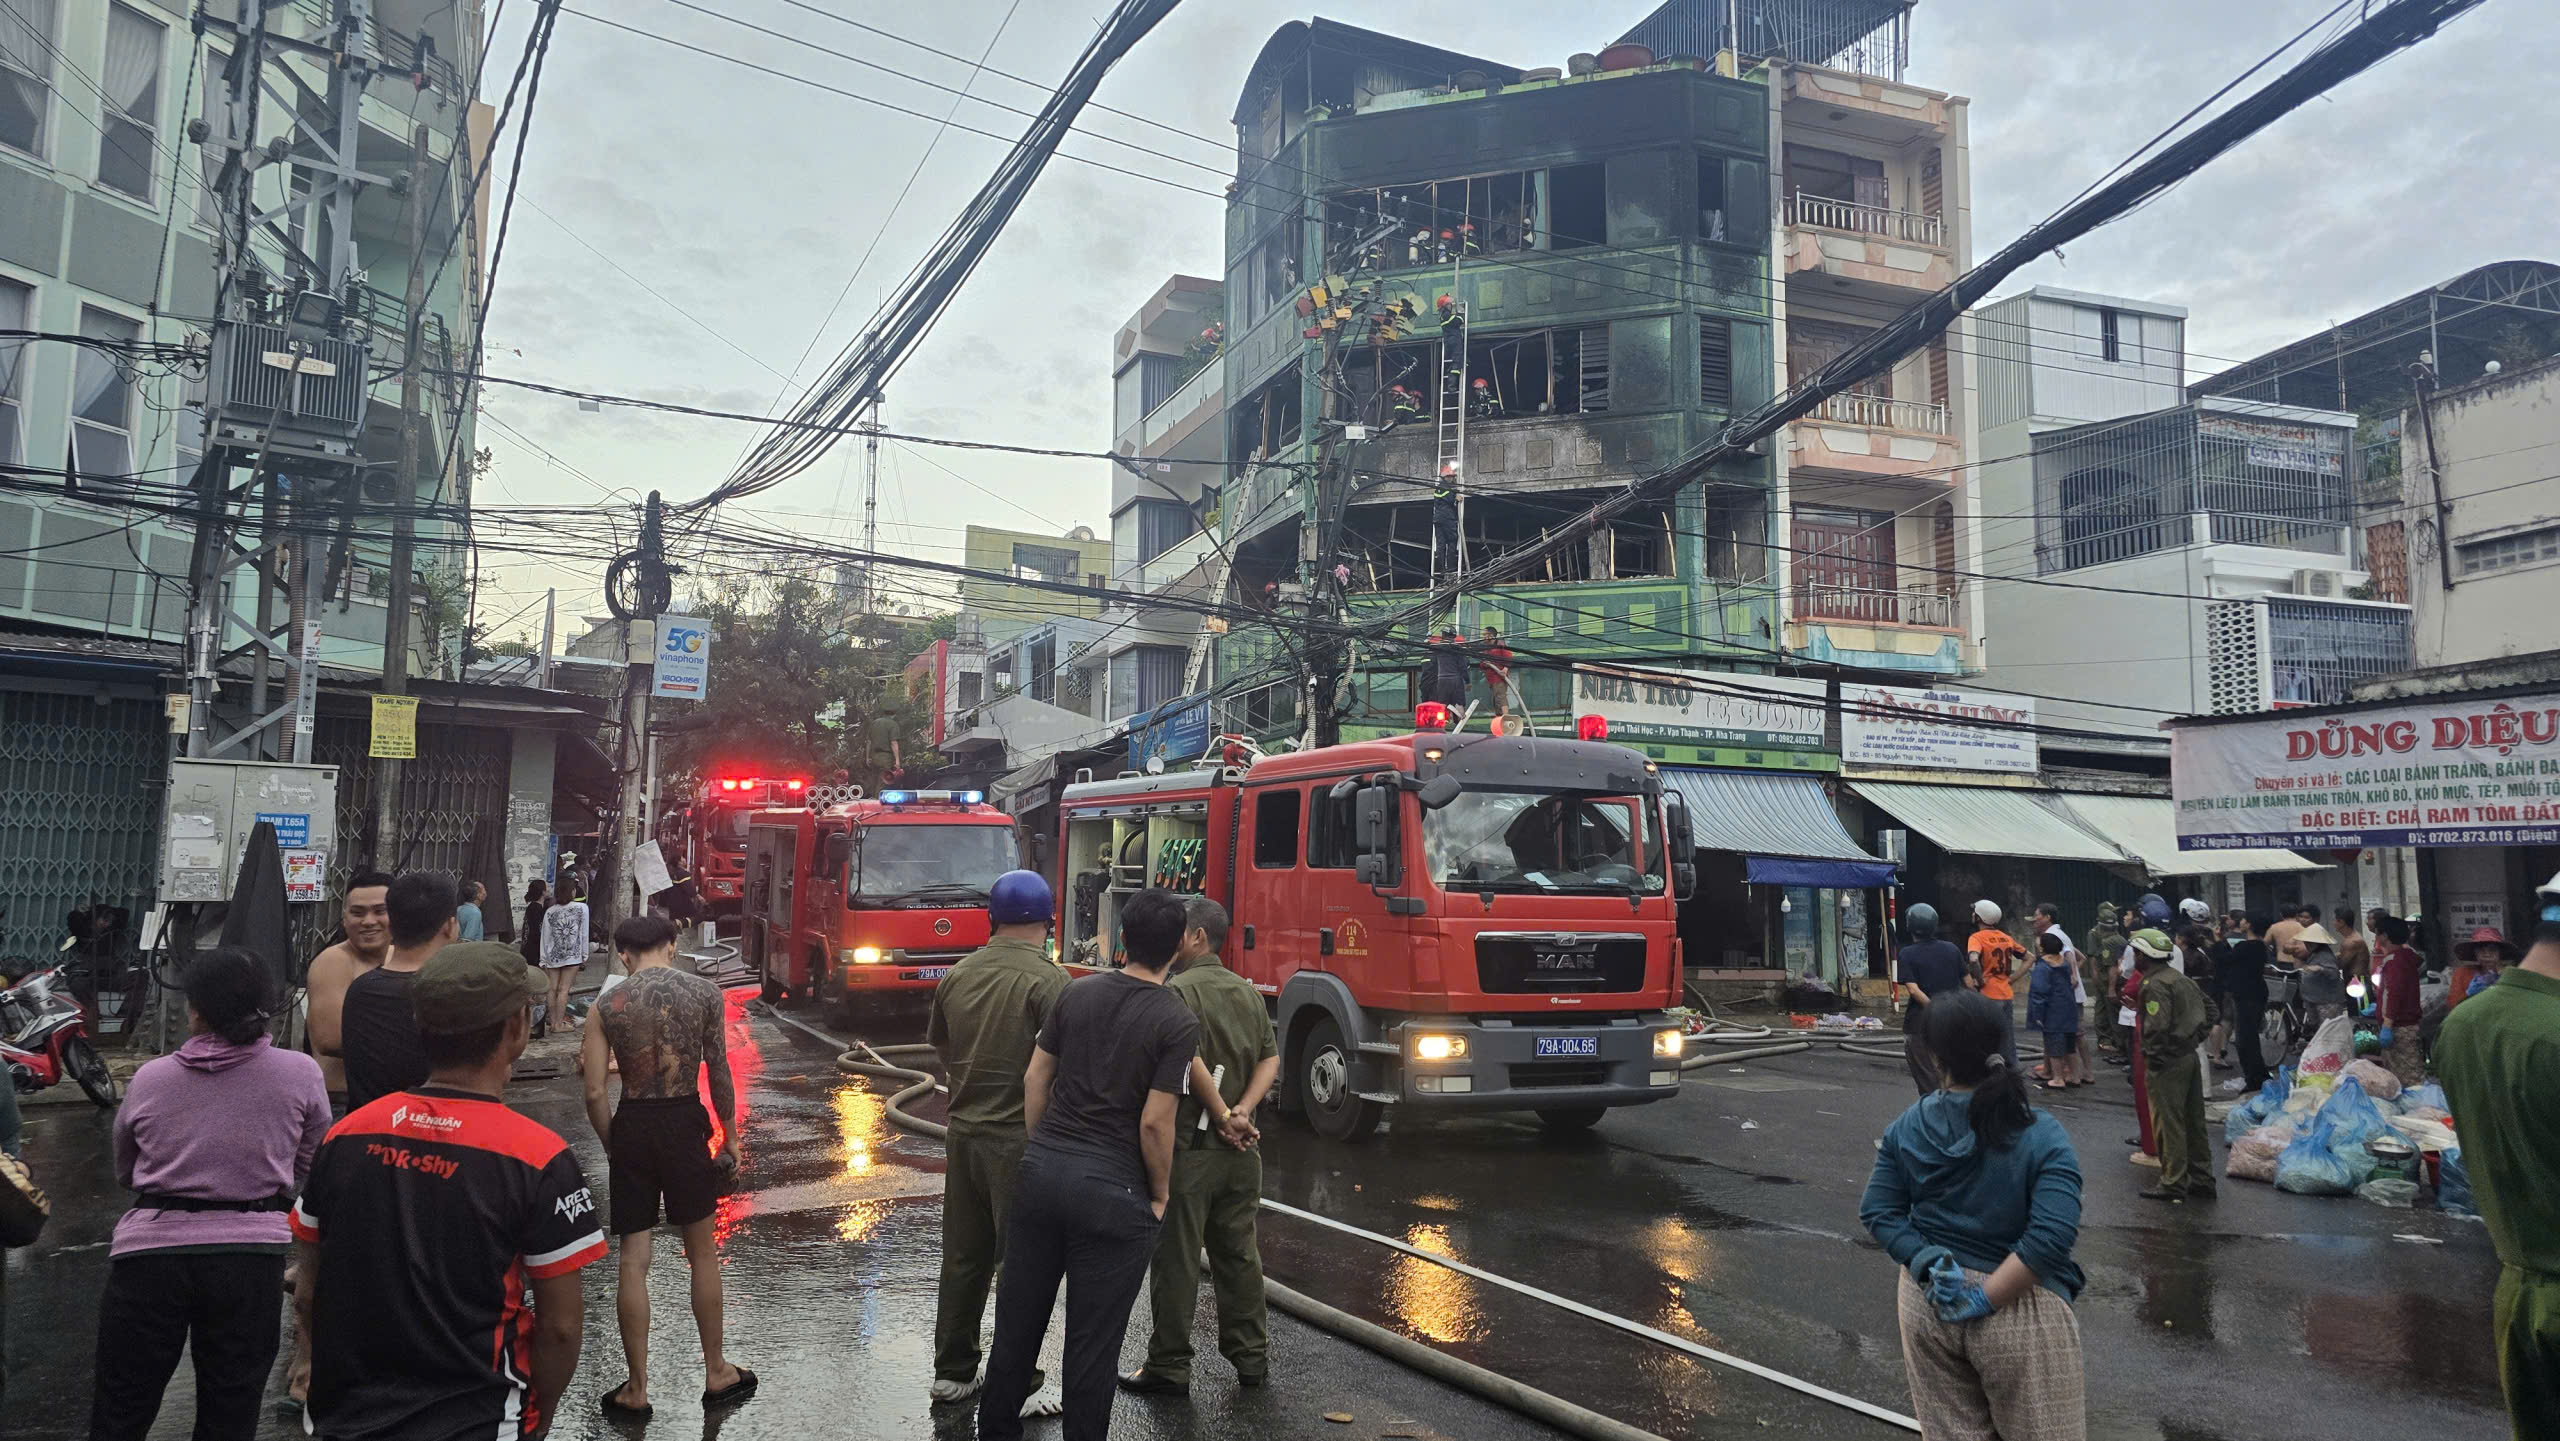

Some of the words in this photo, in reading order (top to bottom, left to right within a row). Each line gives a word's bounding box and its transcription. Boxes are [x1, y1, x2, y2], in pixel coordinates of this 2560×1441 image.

[660, 653, 705, 664] vinaphone
[1606, 722, 1625, 733] guyễn
[1641, 725, 1654, 736] Học
[1716, 730, 1729, 740] Nha
[1729, 731, 1746, 742] Trang
[2286, 719, 2420, 761] DŨNG
[2432, 703, 2560, 756] DIỆU
[2255, 776, 2294, 791] Chuyên
[2311, 774, 2325, 787] và
[2346, 768, 2370, 785] CÁC
[2374, 768, 2400, 785] LOẠI
[2405, 763, 2440, 781] BÁNH
[2444, 761, 2493, 779] TRÁNG,
[2496, 759, 2535, 776] BÁNH
[2540, 759, 2560, 775] ĐA
[2216, 795, 2238, 811] LIỆU
[2240, 794, 2260, 808] LÀM
[2263, 791, 2291, 807] BÁNH
[2293, 790, 2328, 806] TRÁNG
[2332, 790, 2364, 808] TRỘN,
[2367, 787, 2390, 802] KHÔ
[2415, 785, 2439, 801] KHÔ
[2443, 784, 2474, 802] MỰC,
[2302, 810, 2335, 830] ĐẶC
[2340, 808, 2381, 829] BIỆT:
[2386, 804, 2421, 825] CHẢ
[2427, 807, 2469, 824] RAM
[2474, 803, 2517, 823] TÔM
[2523, 799, 2560, 821] ĐẤT
[2246, 836, 2267, 847] Thái
[2268, 836, 2292, 848] Học,
[2294, 836, 2303, 846] P.
[2306, 835, 2326, 848] Vạn
[2328, 834, 2362, 848] Thạnh
[2429, 831, 2514, 843] 0702.873.016
[1537, 954, 1595, 969] MAN
[920, 969, 949, 978] 79A-00
